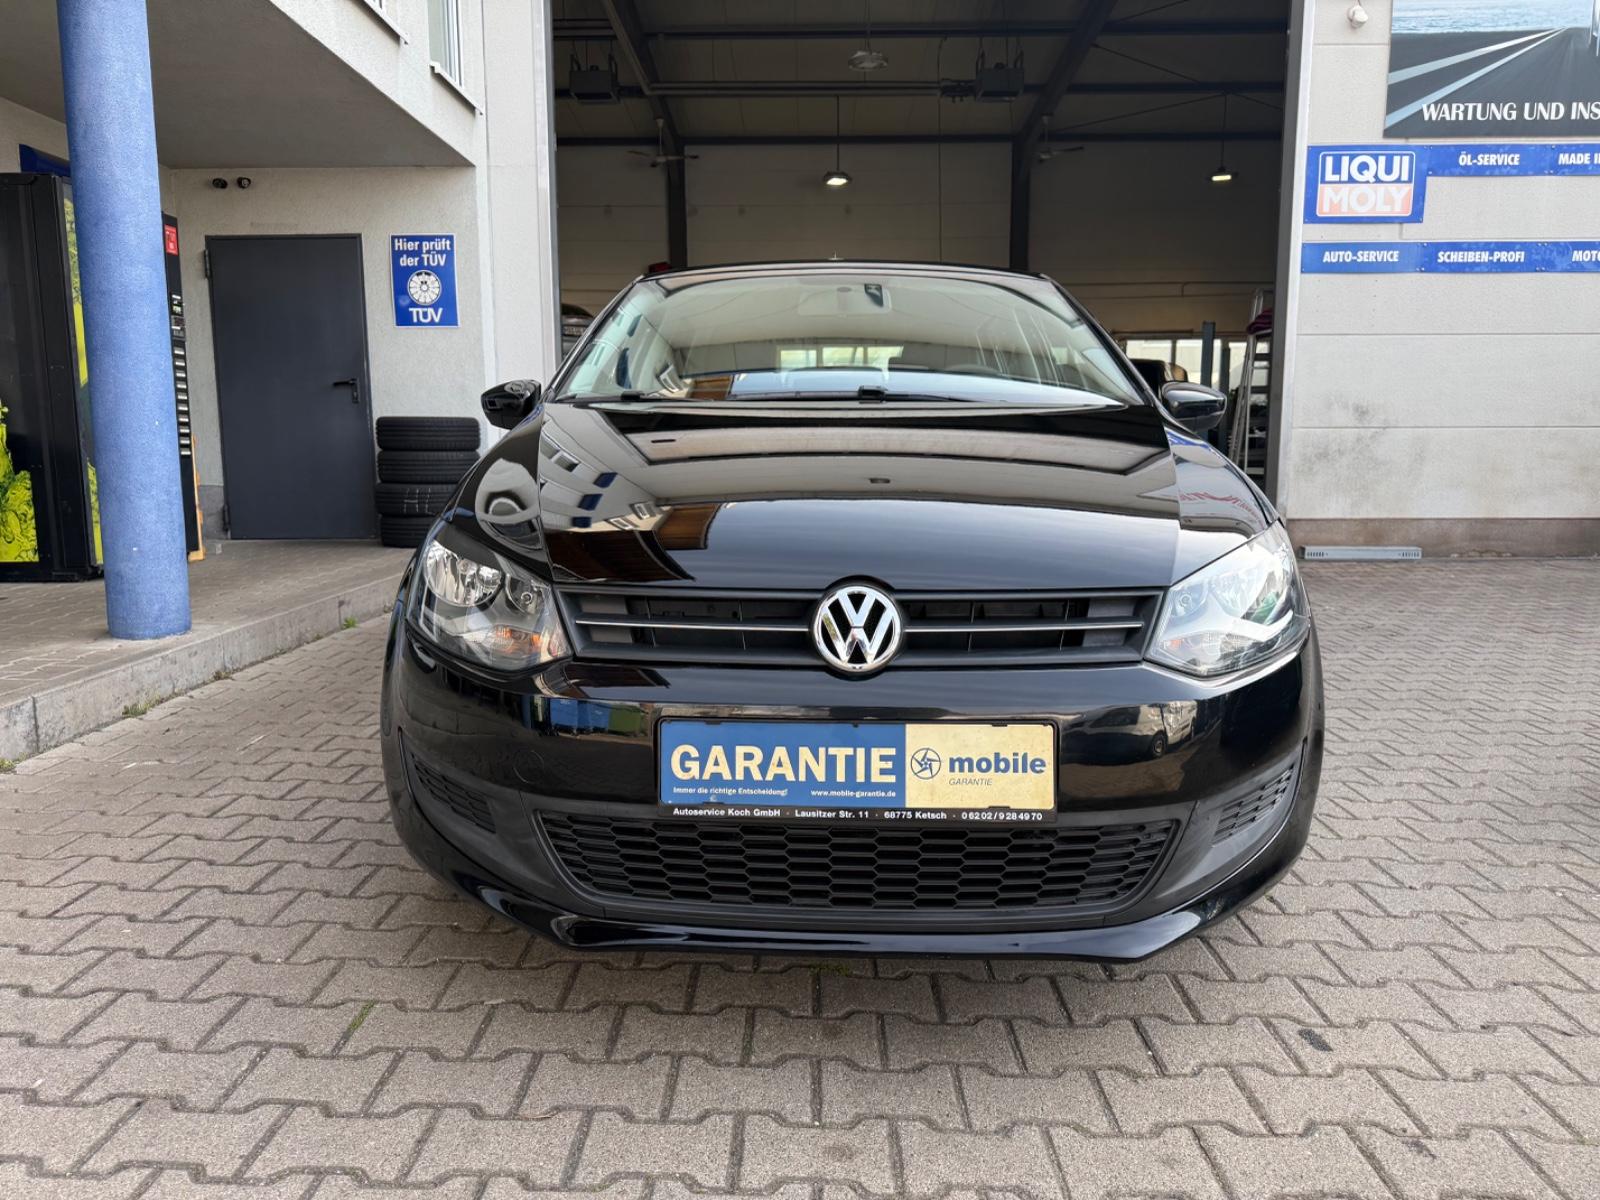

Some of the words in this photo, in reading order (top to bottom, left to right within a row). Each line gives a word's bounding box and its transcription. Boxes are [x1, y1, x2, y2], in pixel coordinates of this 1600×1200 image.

[1422, 102, 1517, 121] WARTUNG
[1523, 102, 1565, 121] UND
[1458, 151, 1520, 166] ÖL-SERVICE
[1558, 153, 1591, 165] MADE
[1593, 153, 1600, 165] I
[1324, 155, 1409, 183] LIQUI
[1322, 184, 1412, 214] MOLY
[394, 238, 419, 251] Hier
[422, 238, 451, 254] prüft
[399, 254, 419, 266] der
[422, 251, 446, 266] TÜV
[1323, 250, 1399, 263] AUTO-SERVICE
[1437, 250, 1525, 263] SCHEIBEN-PROFI
[408, 307, 443, 323] TÜV
[670, 744, 897, 783] GARANTIE
[948, 752, 1047, 774] mobile
[948, 777, 993, 786] GARANTIE
[672, 786, 696, 794] Immer
[697, 786, 708, 795] die
[709, 786, 737, 796] richtige
[810, 789, 897, 798] www.mobile-garantie.de
[672, 807, 726, 817] Autoservice
[727, 808, 751, 817] Koch
[753, 809, 781, 818] GmbH
[794, 809, 837, 819] Lausitzer
[838, 810, 856, 819] Str.
[859, 811, 869, 820] 11
[883, 811, 912, 820] 68775
[915, 811, 947, 820] Ketsch
